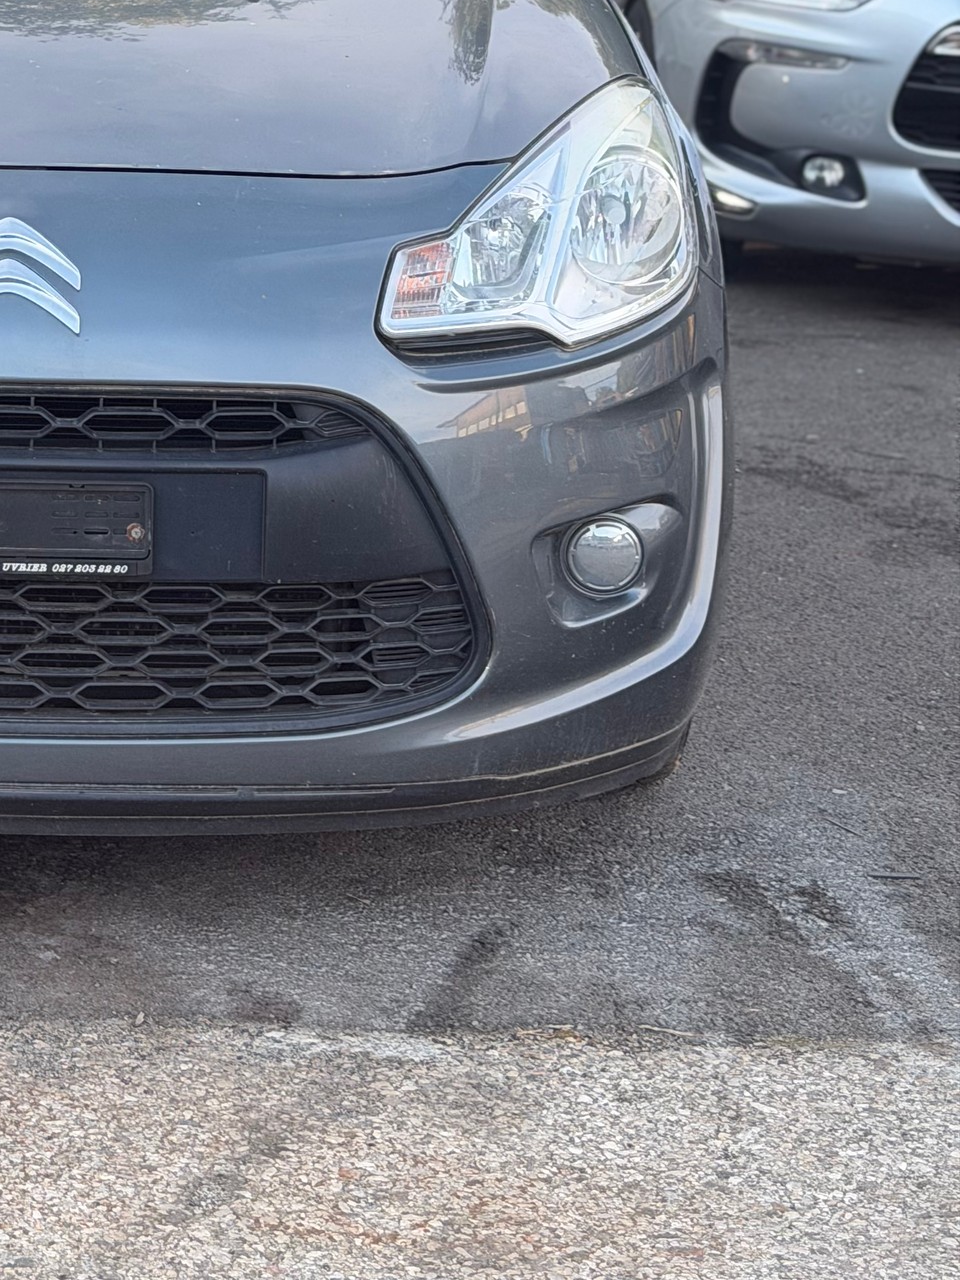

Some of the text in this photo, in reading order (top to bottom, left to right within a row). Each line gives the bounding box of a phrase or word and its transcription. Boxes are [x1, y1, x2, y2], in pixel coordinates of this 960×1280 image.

[1, 562, 48, 573] UVRIER
[51, 563, 73, 573] 027
[74, 563, 97, 573] 203
